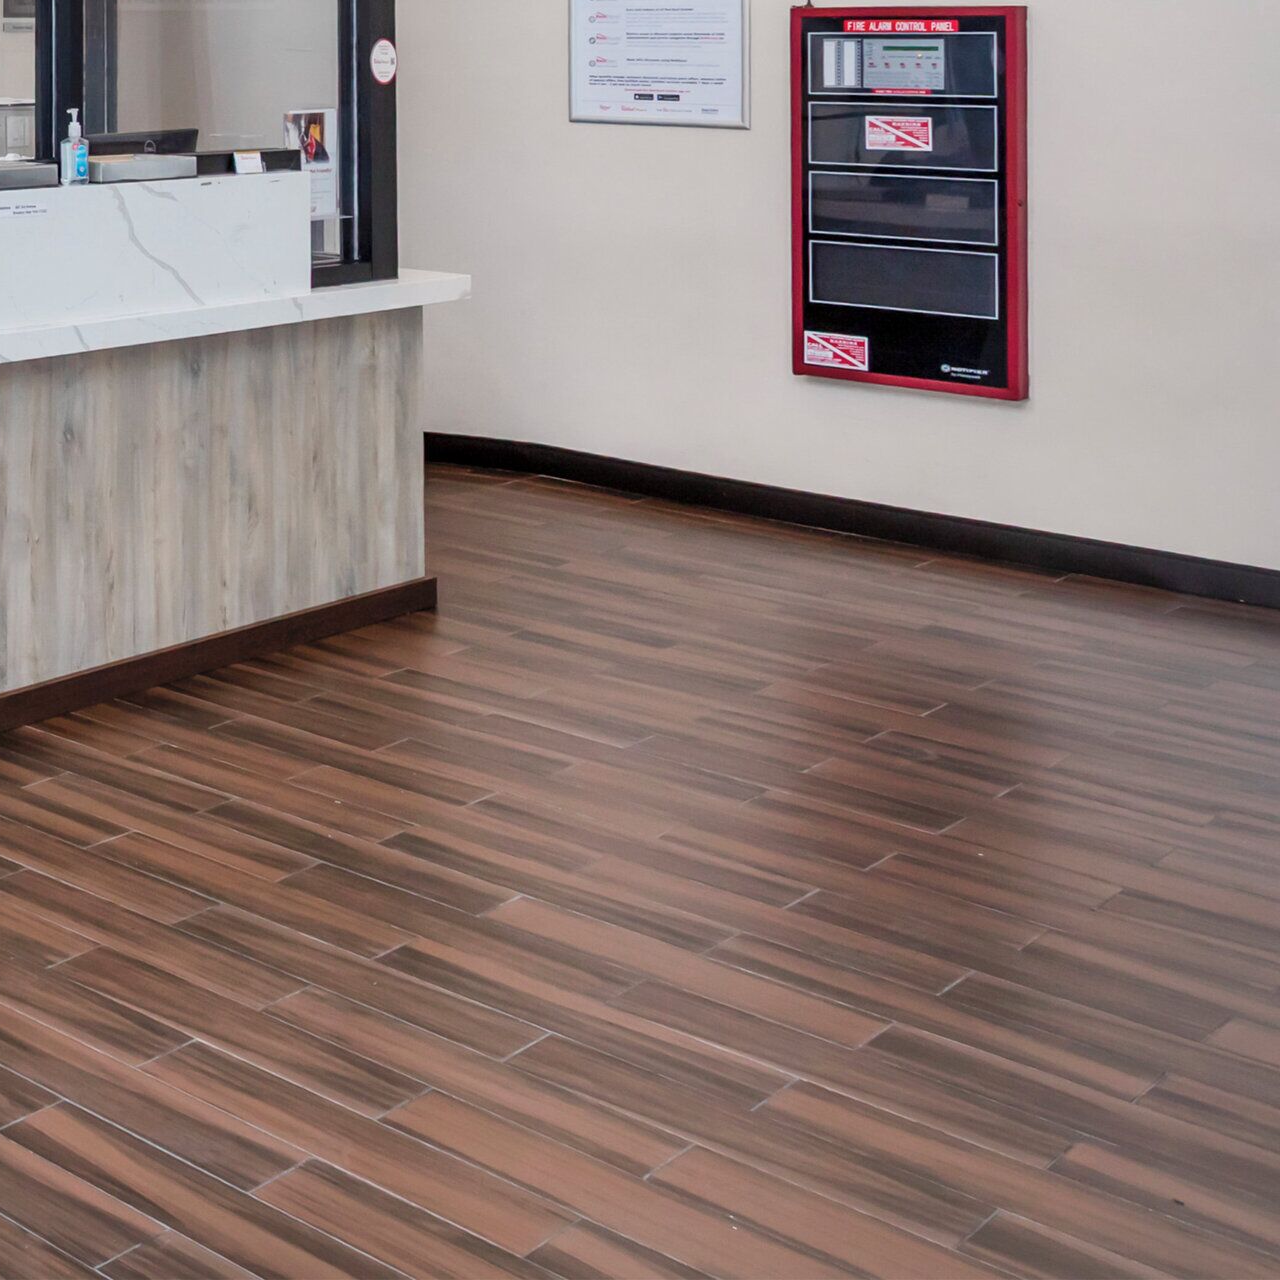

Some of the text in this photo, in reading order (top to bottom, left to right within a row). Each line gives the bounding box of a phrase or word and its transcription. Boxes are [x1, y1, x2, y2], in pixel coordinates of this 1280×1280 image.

[847, 22, 954, 32] FIRE ALARM CONTROL PANEL
